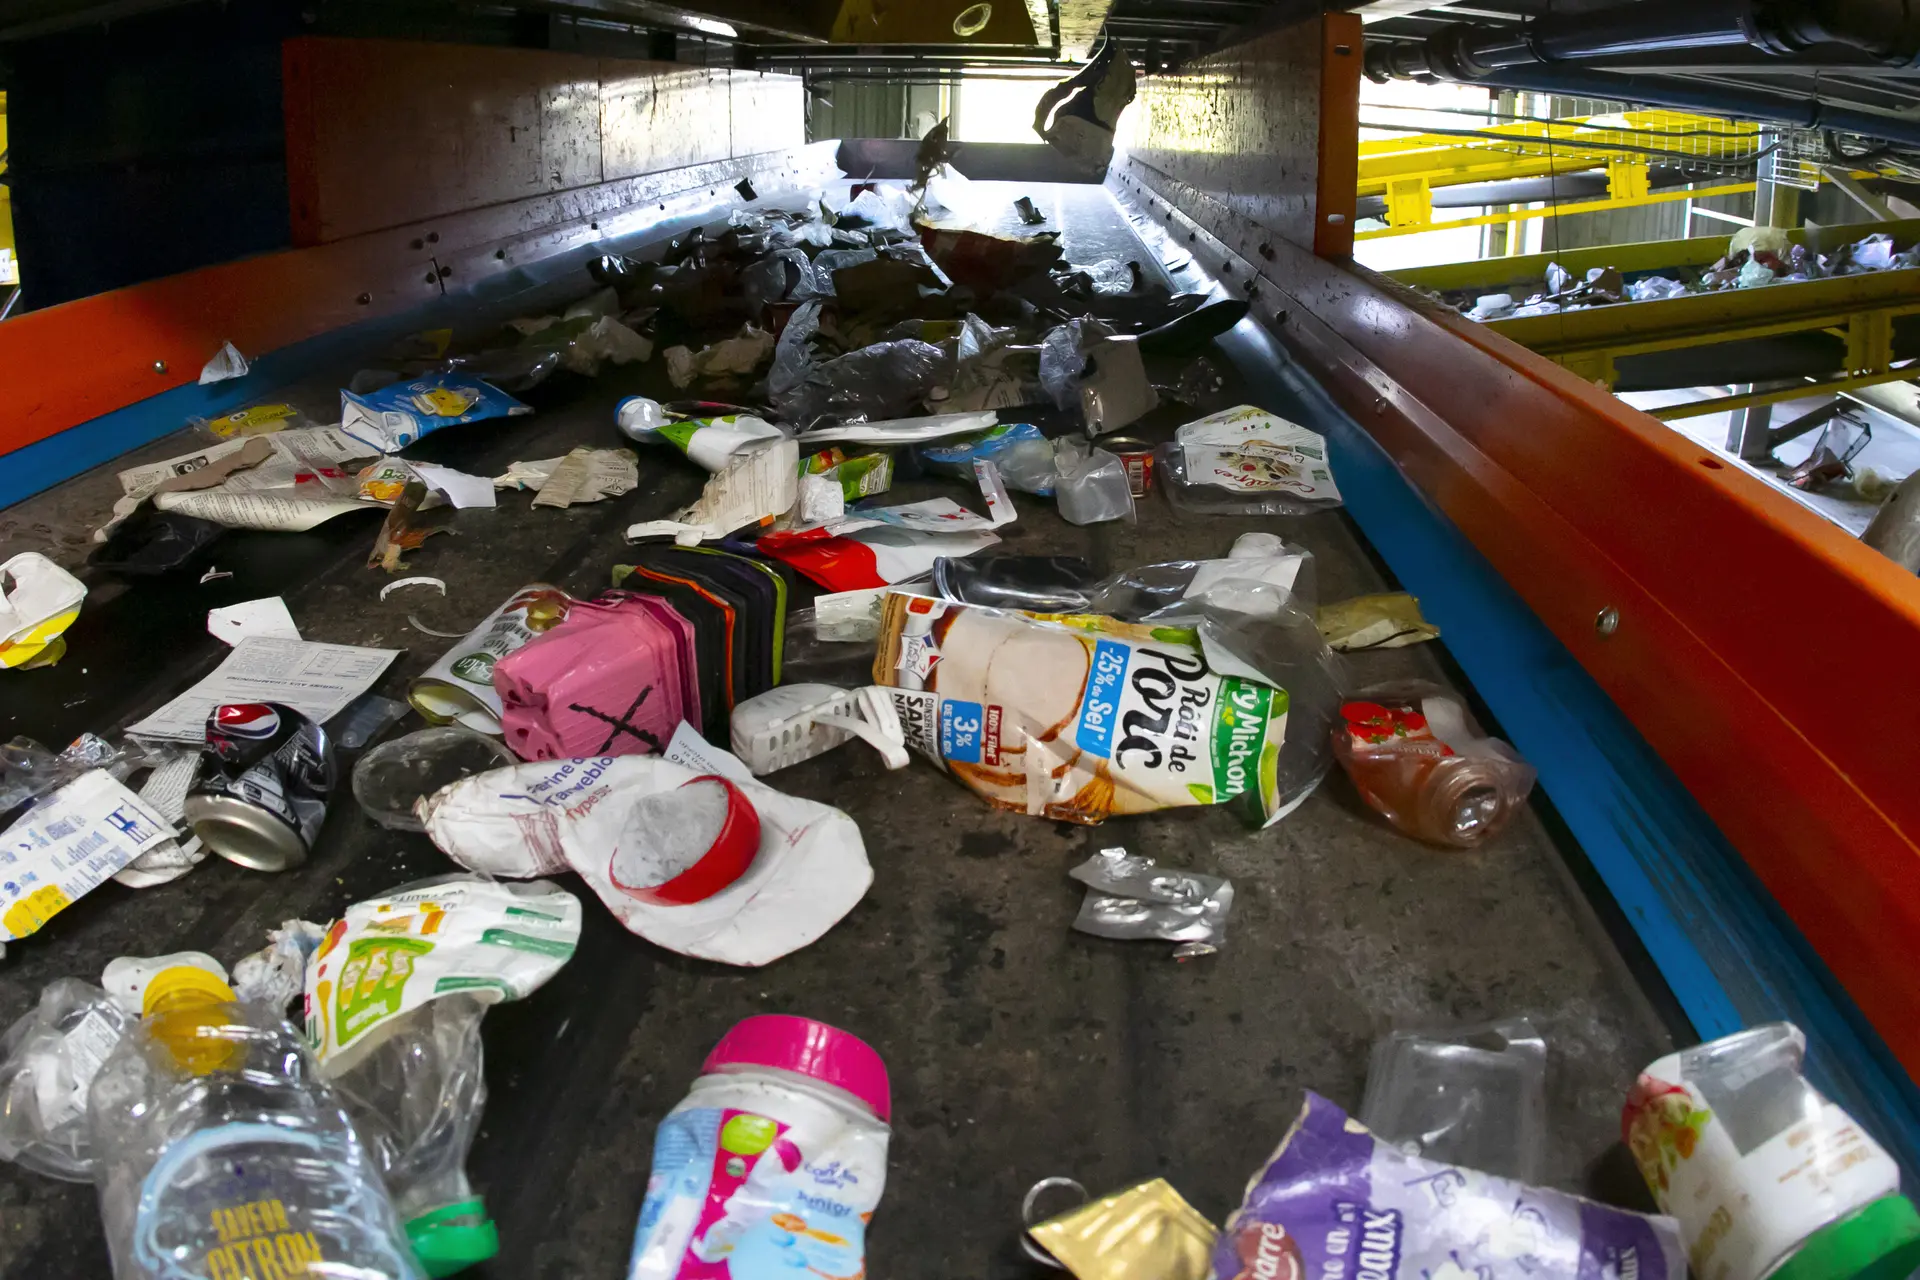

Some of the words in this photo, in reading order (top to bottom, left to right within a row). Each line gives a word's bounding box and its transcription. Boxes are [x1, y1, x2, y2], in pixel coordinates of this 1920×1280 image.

[1092, 648, 1123, 683] -25%
[989, 710, 999, 733] 100%
[1116, 650, 1207, 767] Porc
[954, 717, 979, 746] 3%
[1168, 745, 1189, 772] de
[1226, 710, 1262, 793] Michon
